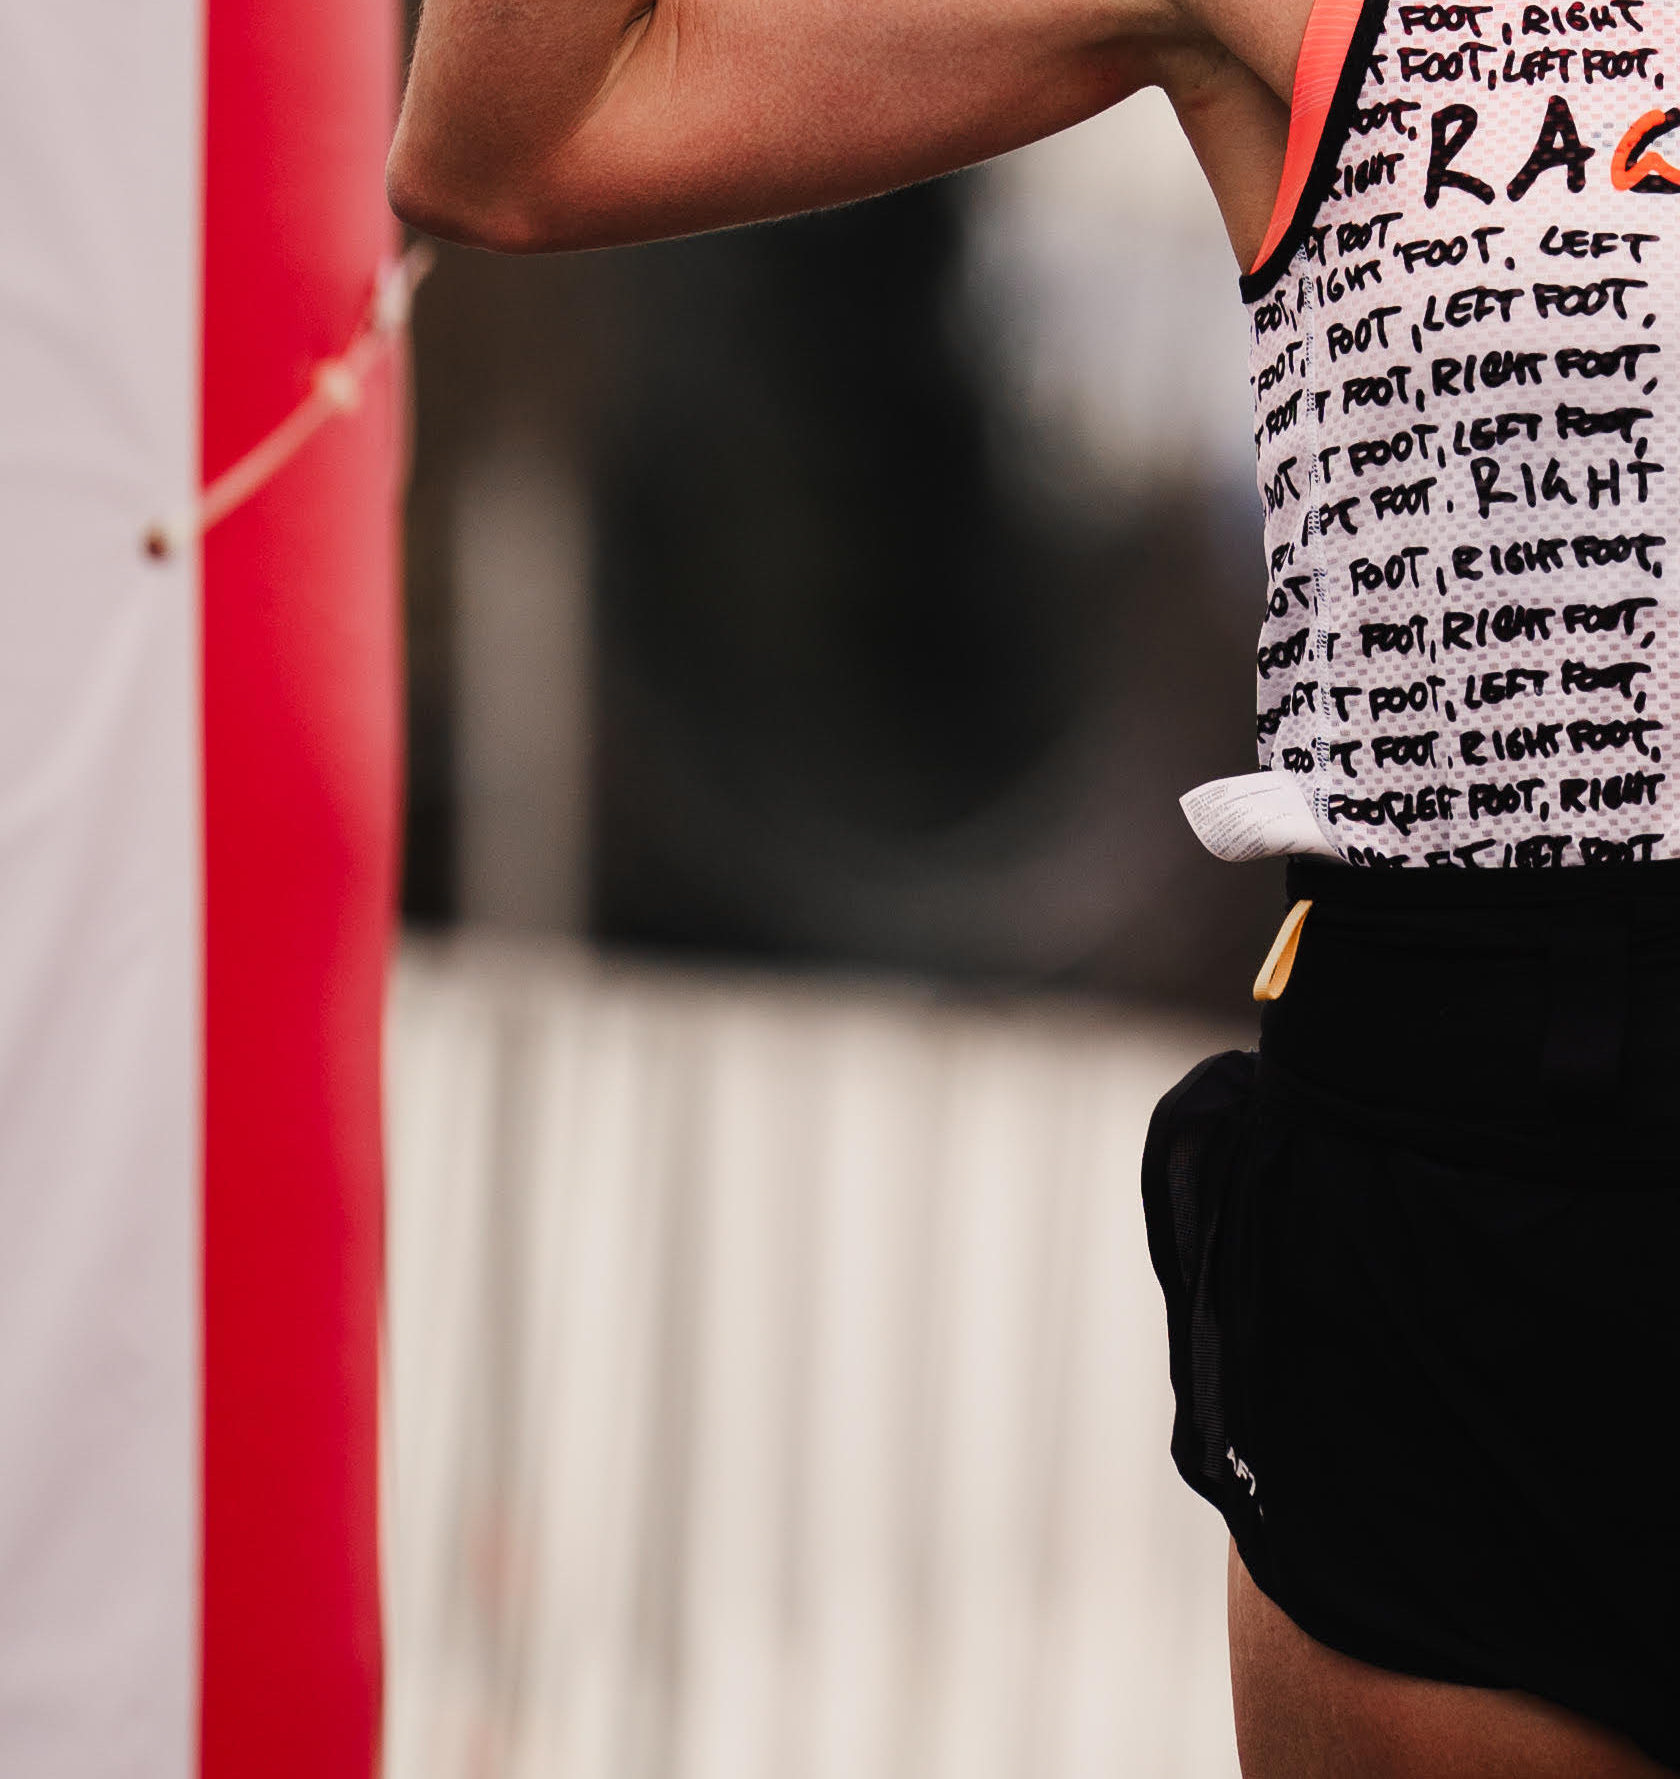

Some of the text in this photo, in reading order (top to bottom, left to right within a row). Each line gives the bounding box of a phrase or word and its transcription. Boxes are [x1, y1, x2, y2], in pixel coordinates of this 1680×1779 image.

[1539, 224, 1660, 264] LEFT
[1423, 286, 1525, 332] LEFT
[1453, 413, 1543, 456] LEFT
[1470, 456, 1665, 519] RIGHT
[1464, 669, 1550, 709] LEFT
